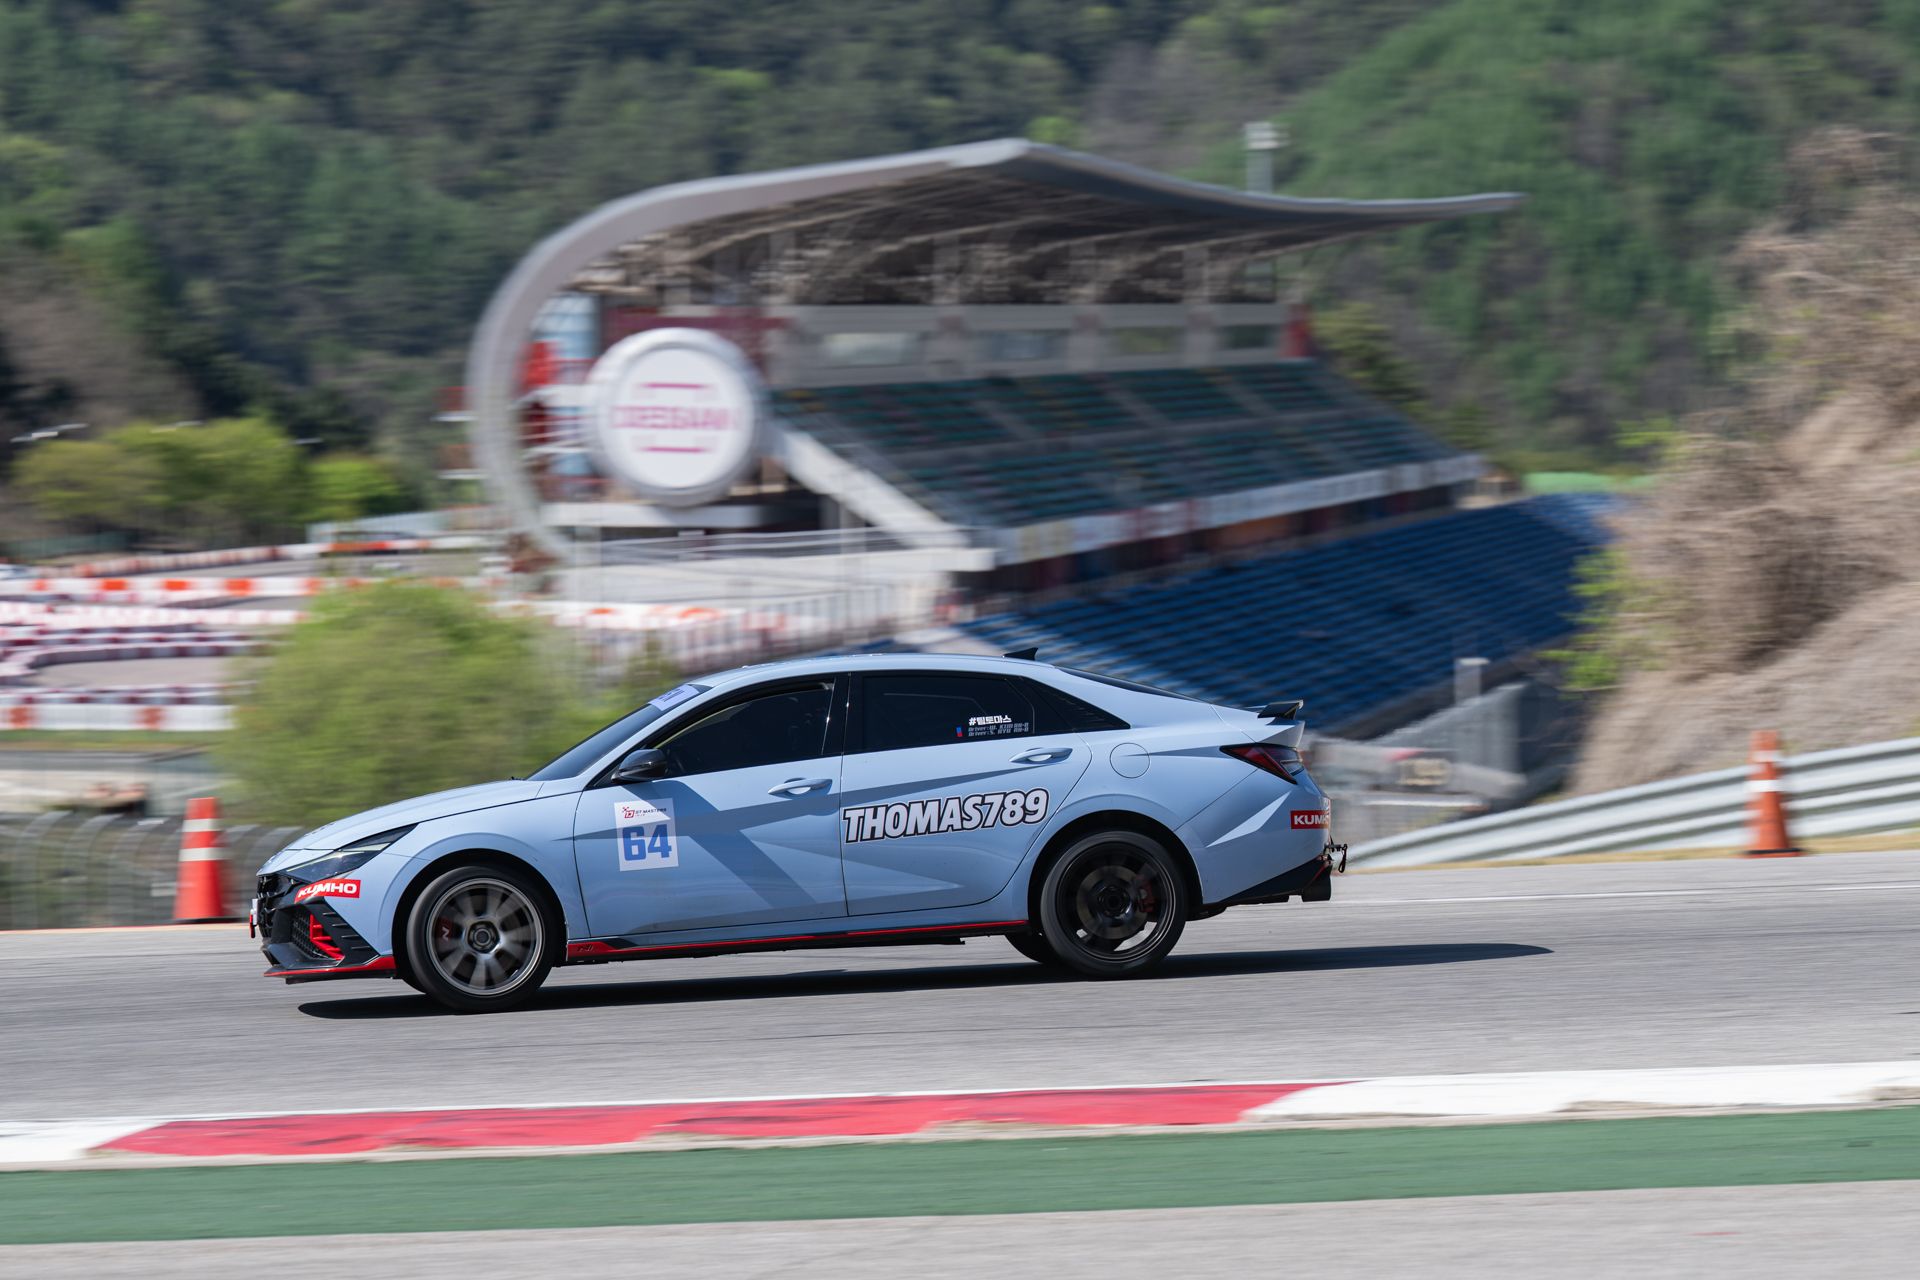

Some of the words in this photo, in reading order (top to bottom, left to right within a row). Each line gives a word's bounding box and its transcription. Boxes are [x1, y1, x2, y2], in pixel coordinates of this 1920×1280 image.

[843, 787, 1050, 844] THOMAS789
[622, 824, 672, 861] 64
[298, 882, 357, 897] KUMHO
